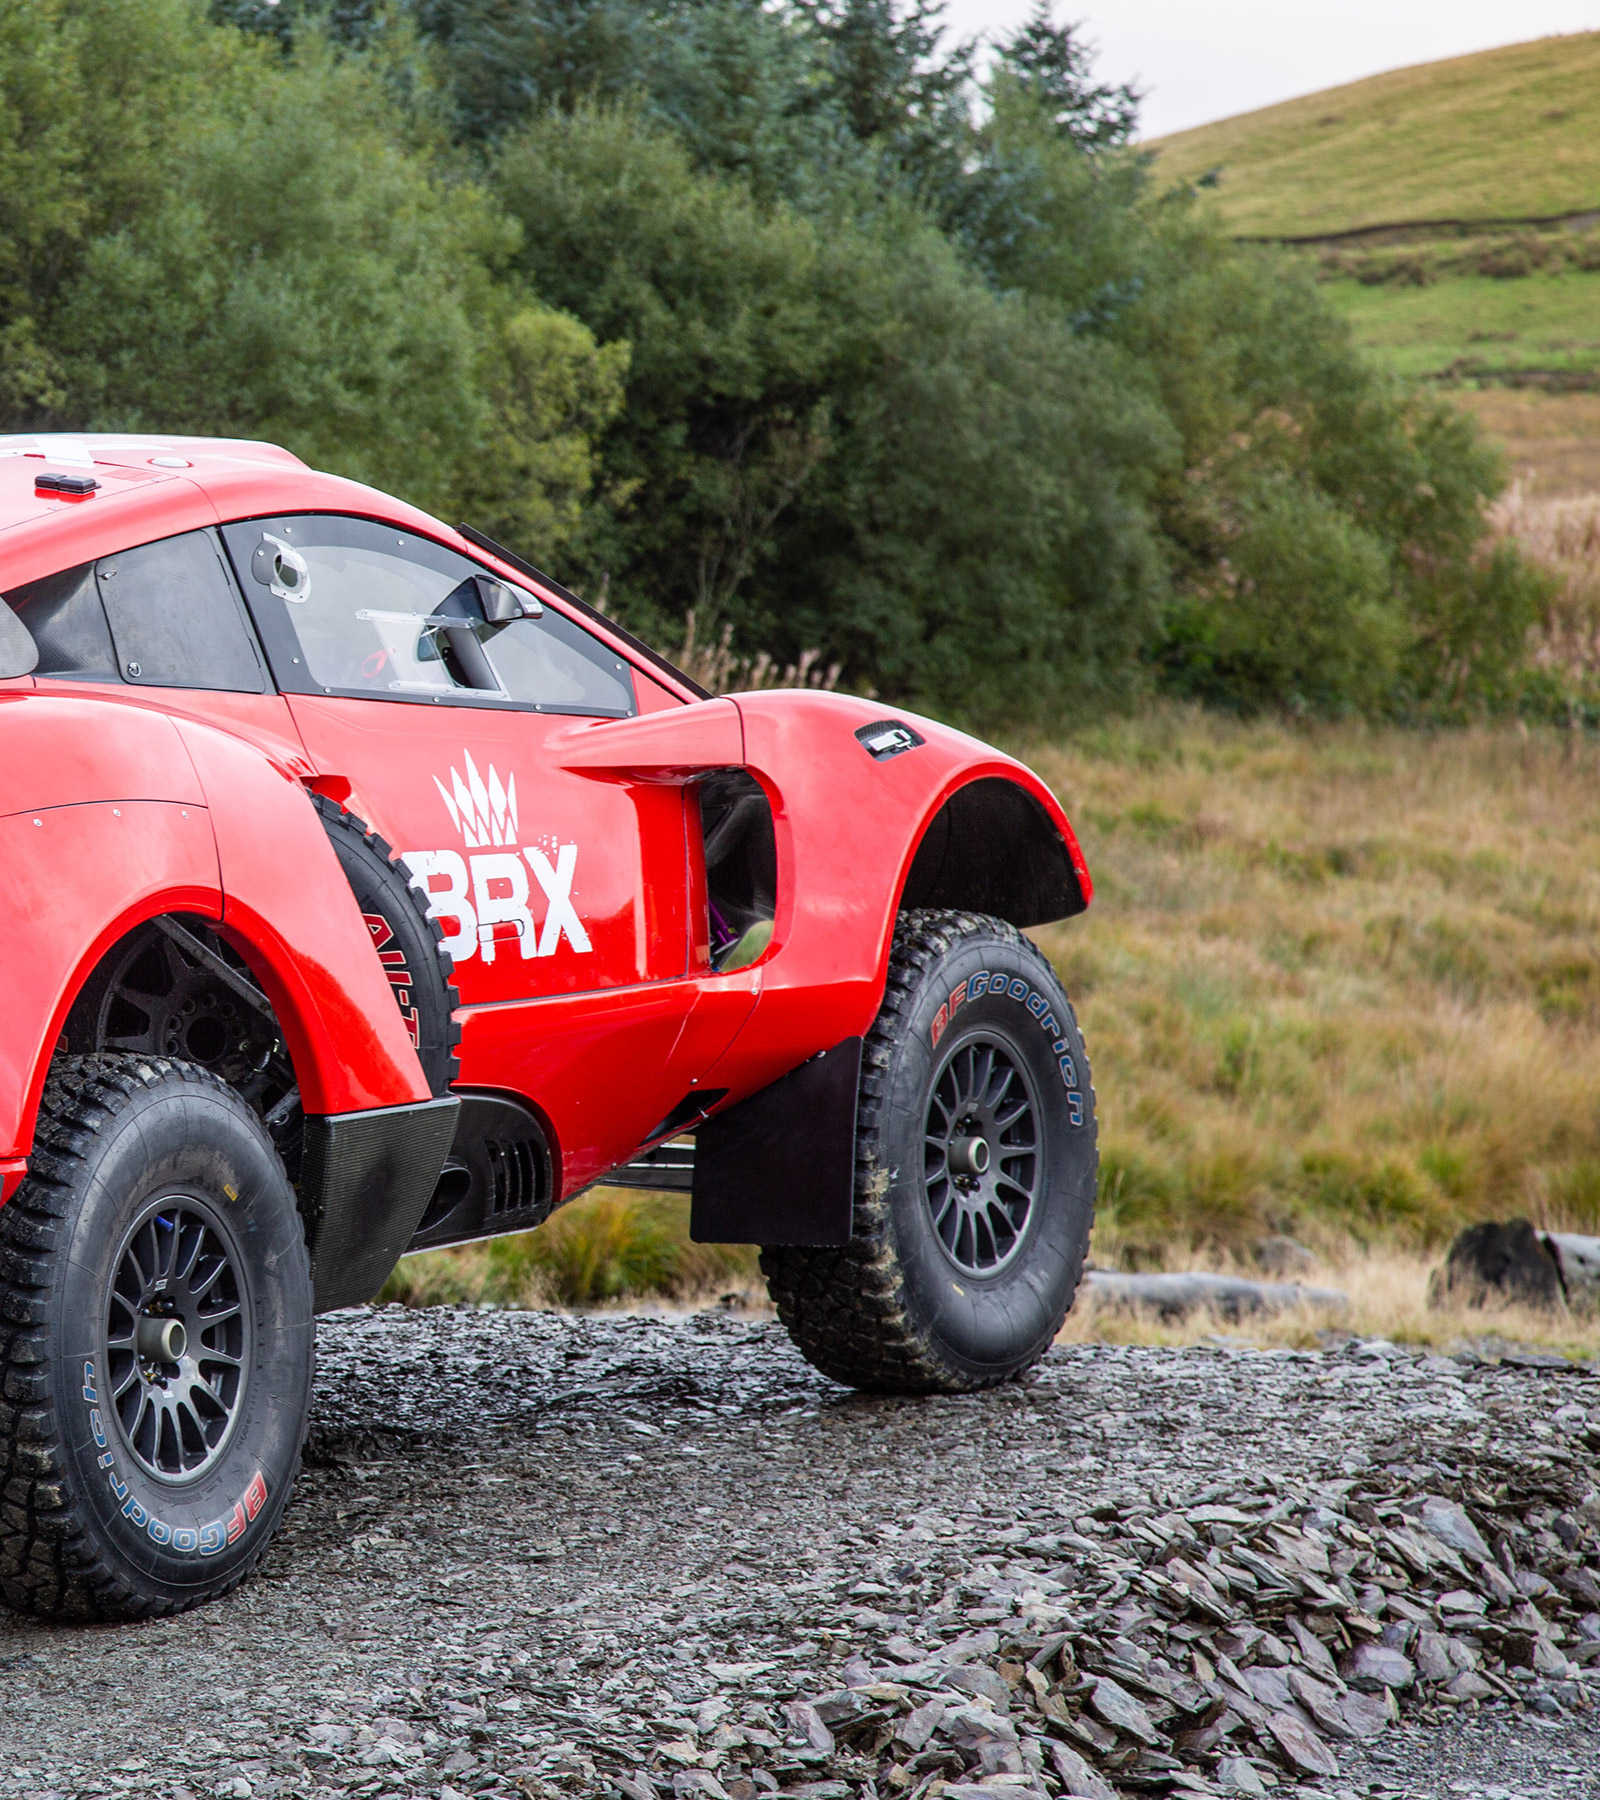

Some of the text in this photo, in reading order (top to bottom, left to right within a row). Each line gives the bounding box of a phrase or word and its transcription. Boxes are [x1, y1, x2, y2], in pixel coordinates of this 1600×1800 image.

[401, 842, 593, 965] BRX
[931, 970, 1084, 1127] BFGoodrich
[81, 1360, 268, 1556] BFGoodrich
